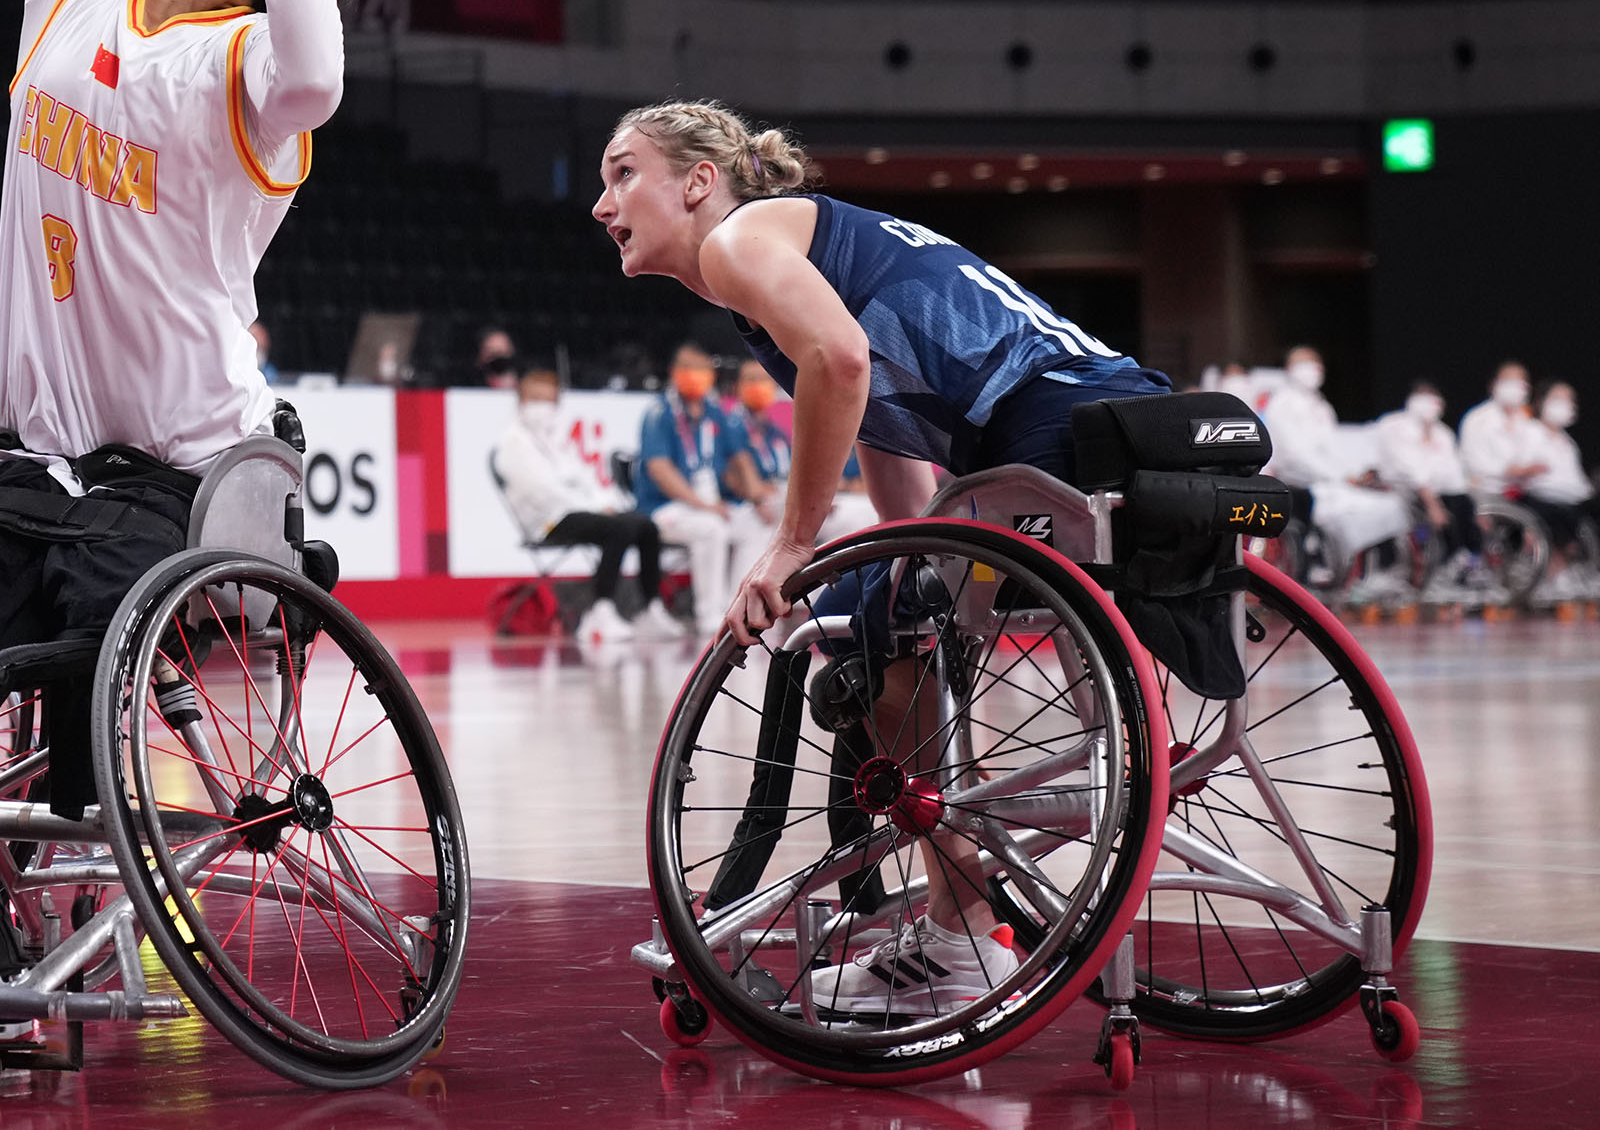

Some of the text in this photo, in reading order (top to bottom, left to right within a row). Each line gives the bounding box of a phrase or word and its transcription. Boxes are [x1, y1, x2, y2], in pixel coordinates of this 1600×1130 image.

[18, 84, 159, 215] CHINA
[1228, 501, 1285, 527] エイミー
